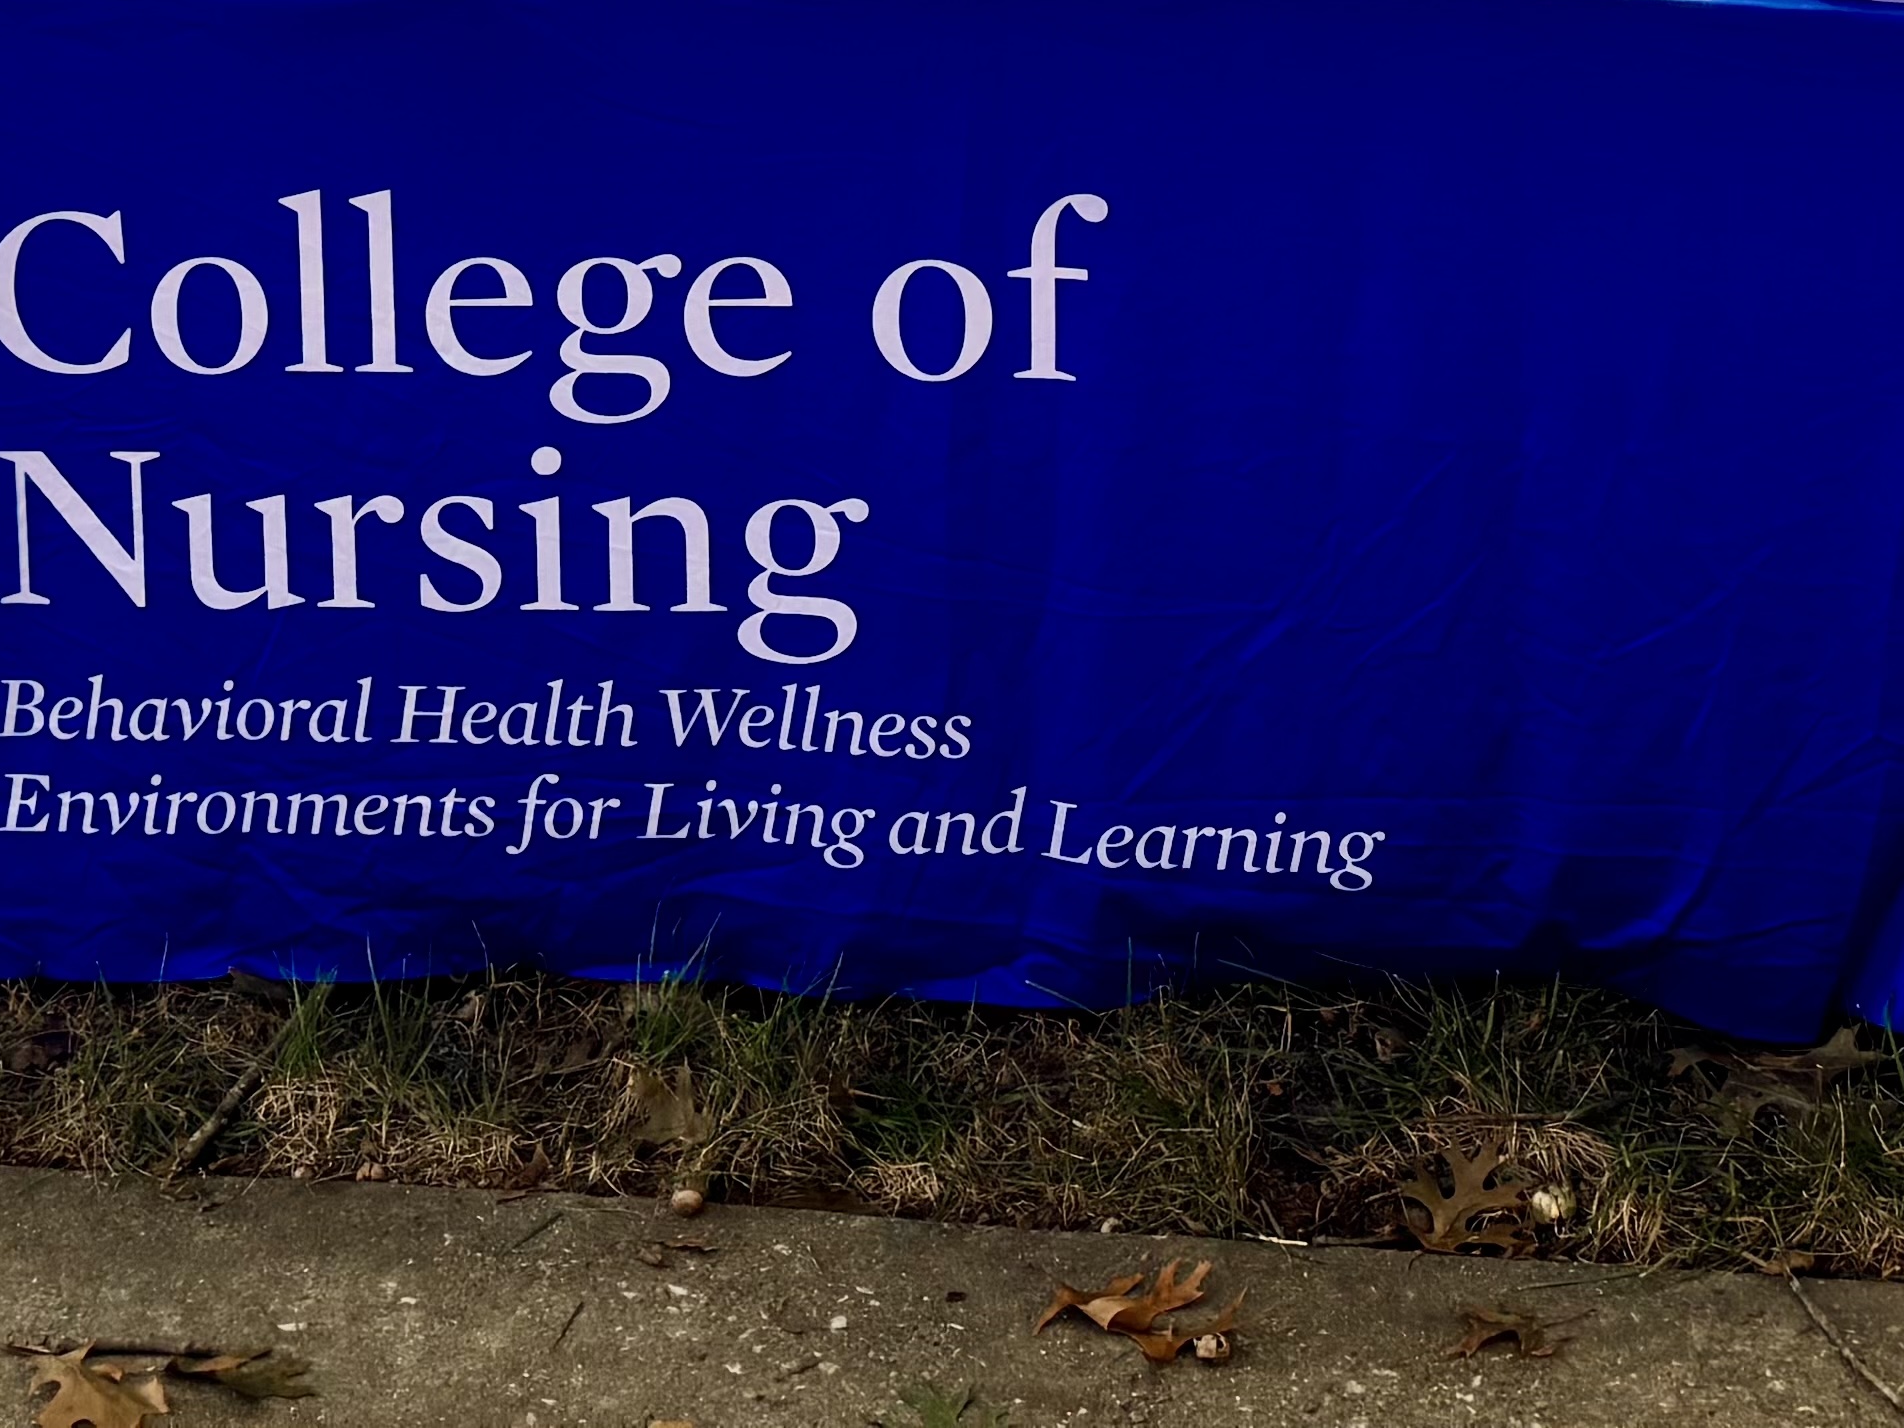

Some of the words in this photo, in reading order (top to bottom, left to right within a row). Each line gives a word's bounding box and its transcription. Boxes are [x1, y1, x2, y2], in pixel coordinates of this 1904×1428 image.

[870, 191, 1110, 384] of
[391, 680, 640, 749] Health
[657, 684, 974, 762] Wellness
[506, 772, 621, 855] for
[638, 780, 876, 869] Living
[889, 787, 1026, 858] and
[1041, 798, 1387, 892] Learning
